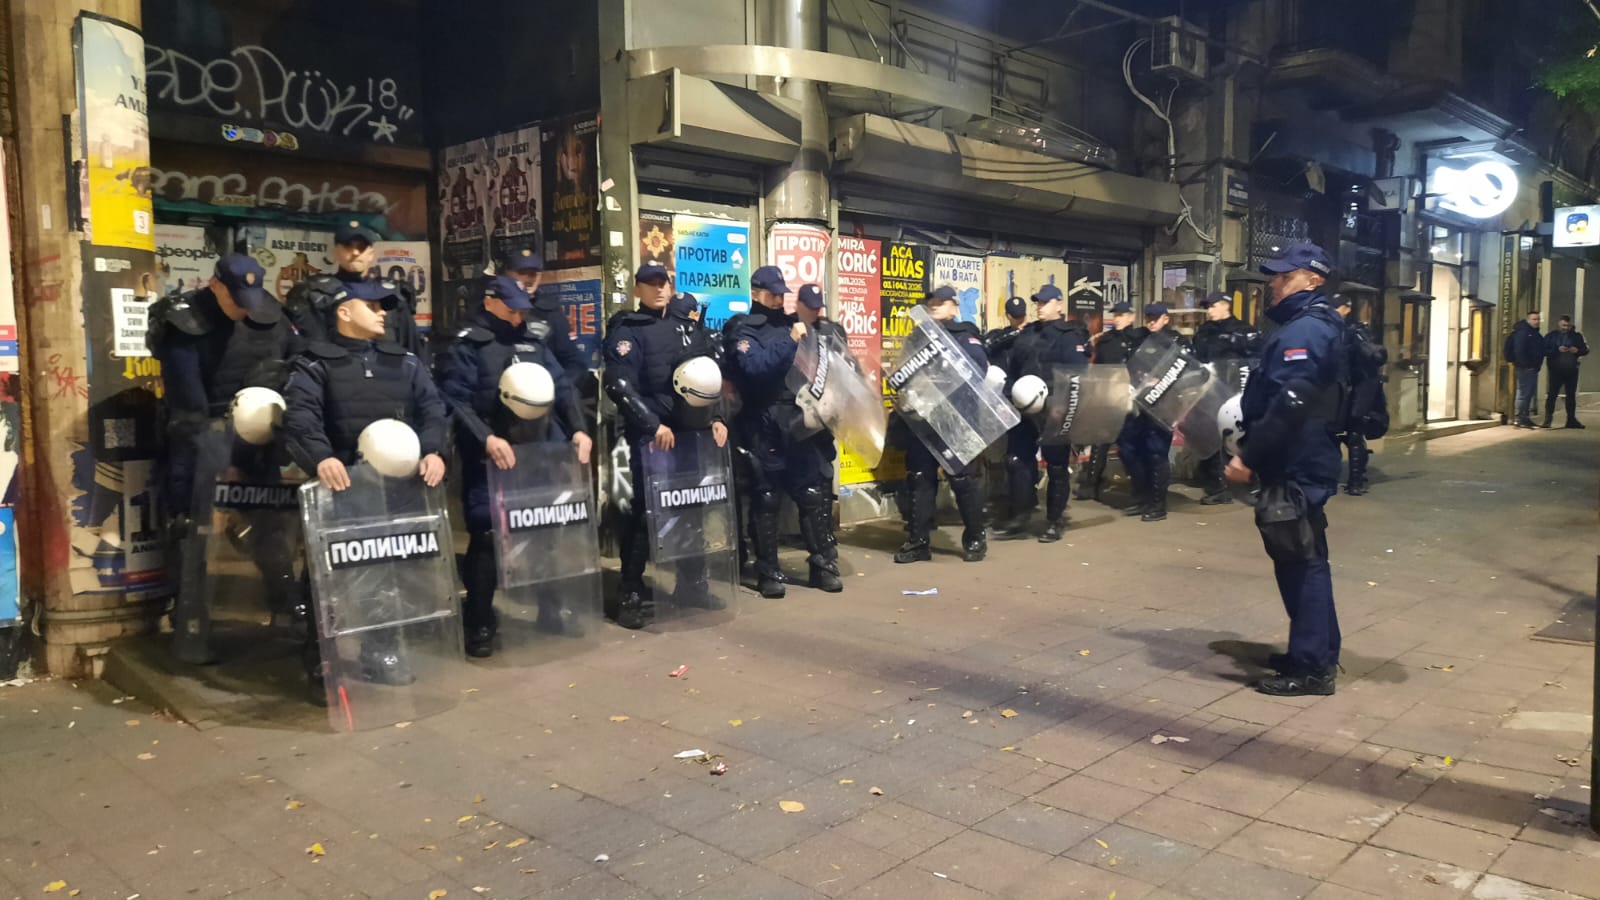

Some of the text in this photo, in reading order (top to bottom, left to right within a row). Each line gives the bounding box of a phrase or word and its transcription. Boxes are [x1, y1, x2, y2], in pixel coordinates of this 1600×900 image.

[678, 246, 728, 263] ПРОТИВ
[890, 246, 913, 259] ACA
[882, 257, 924, 279] LUKAS
[952, 268, 958, 281] 8
[959, 271, 978, 282] RATA
[957, 259, 981, 271] KARTE
[679, 271, 741, 289] ПАРАЗИТА
[1144, 357, 1187, 405] ПОЛИЦИЈА
[660, 484, 728, 508] ПОЛИЦИЈА
[509, 502, 588, 529] ПОЛИЦИЈА
[331, 532, 439, 564] ПОЛИЦИЈА
